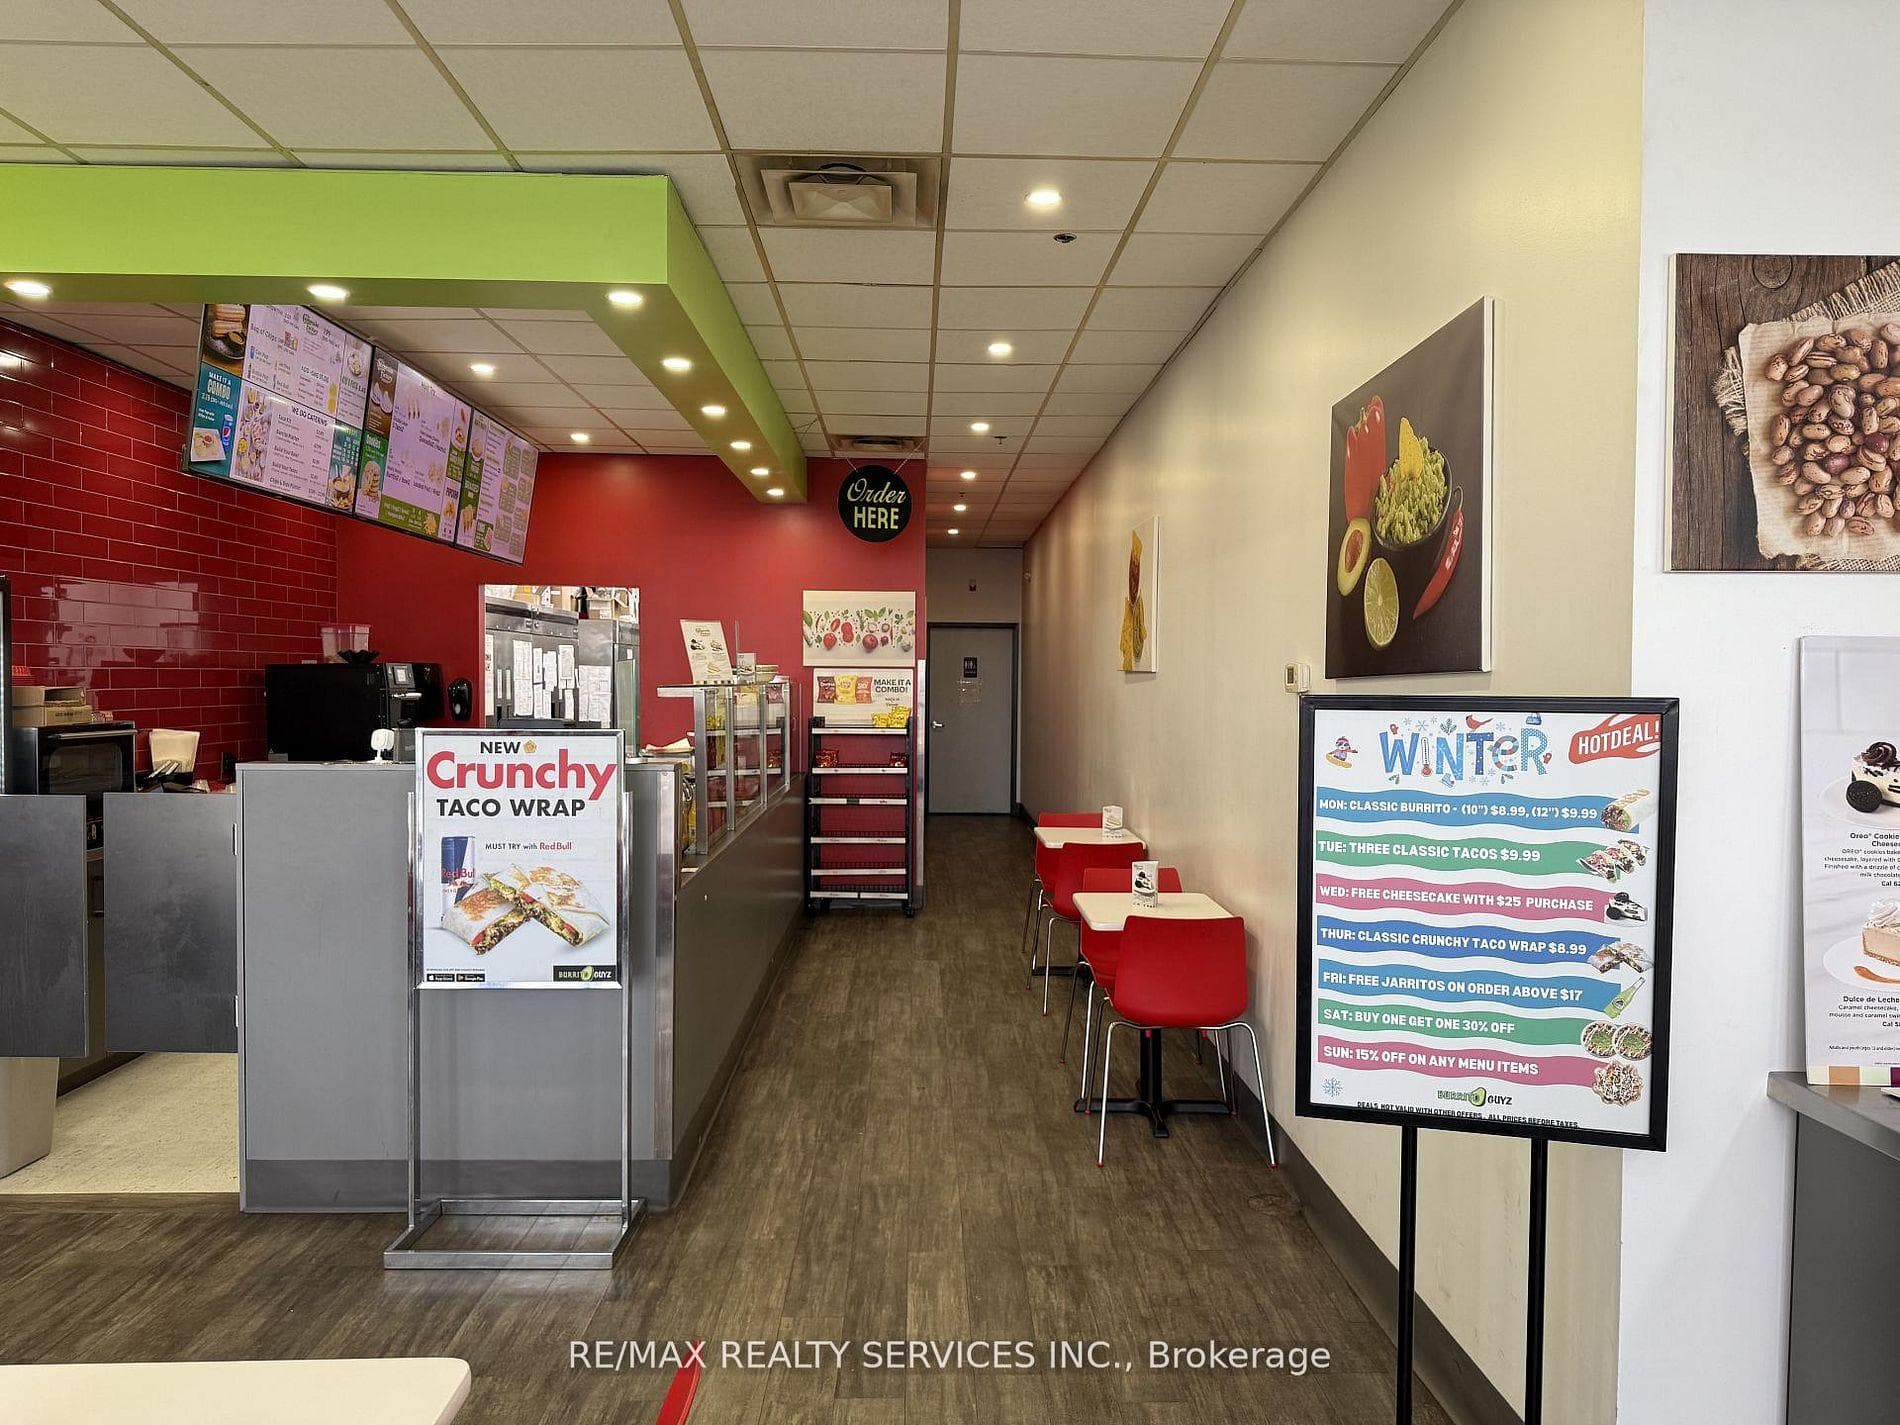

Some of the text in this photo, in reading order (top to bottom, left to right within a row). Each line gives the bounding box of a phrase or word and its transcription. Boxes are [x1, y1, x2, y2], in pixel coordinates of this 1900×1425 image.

[847, 478, 906, 504] Order
[854, 506, 899, 529] HERE
[480, 741, 521, 754] NEW
[426, 748, 618, 800] Crunchy
[436, 798, 586, 817] TACO WRAP
[1319, 798, 1348, 810] MON:
[1350, 801, 1398, 812] CLASSIC
[1400, 802, 1451, 814] BURRITO
[1461, 804, 1488, 816] (10")
[1490, 804, 1530, 818] $8.99,
[1531, 806, 1560, 819] (12")
[1561, 807, 1598, 820] $9.99
[523, 842, 538, 850] with
[1318, 840, 1541, 862] TUE: THREE CLASSIC TACOS $9.99
[1319, 885, 1593, 912] WED: FREE CHEESECAKE WITH $25 PURCHASE
[1320, 927, 1587, 955] THUR: CLASSIC CRUNCHY TACO WRAP $8.99
[1323, 972, 1583, 1001] FRI: FREE JARRITOS ON ORDER ABOVE $17
[1843, 995, 1865, 1003] Dulce
[1323, 1009, 1516, 1034] SAT: BUY ONE GET ONE 30% OFF
[1323, 1045, 1539, 1075] SUN: 15% OFF ON ANY MENU ITEMS
[1357, 1101, 1379, 1109] DEALS
[1395, 1104, 1415, 1112] VALID
[1415, 1106, 1433, 1114] WITH
[1433, 1108, 1455, 1116] OTHER
[1502, 1115, 1527, 1123] PRICES
[1527, 1117, 1555, 1126] BEFORE
